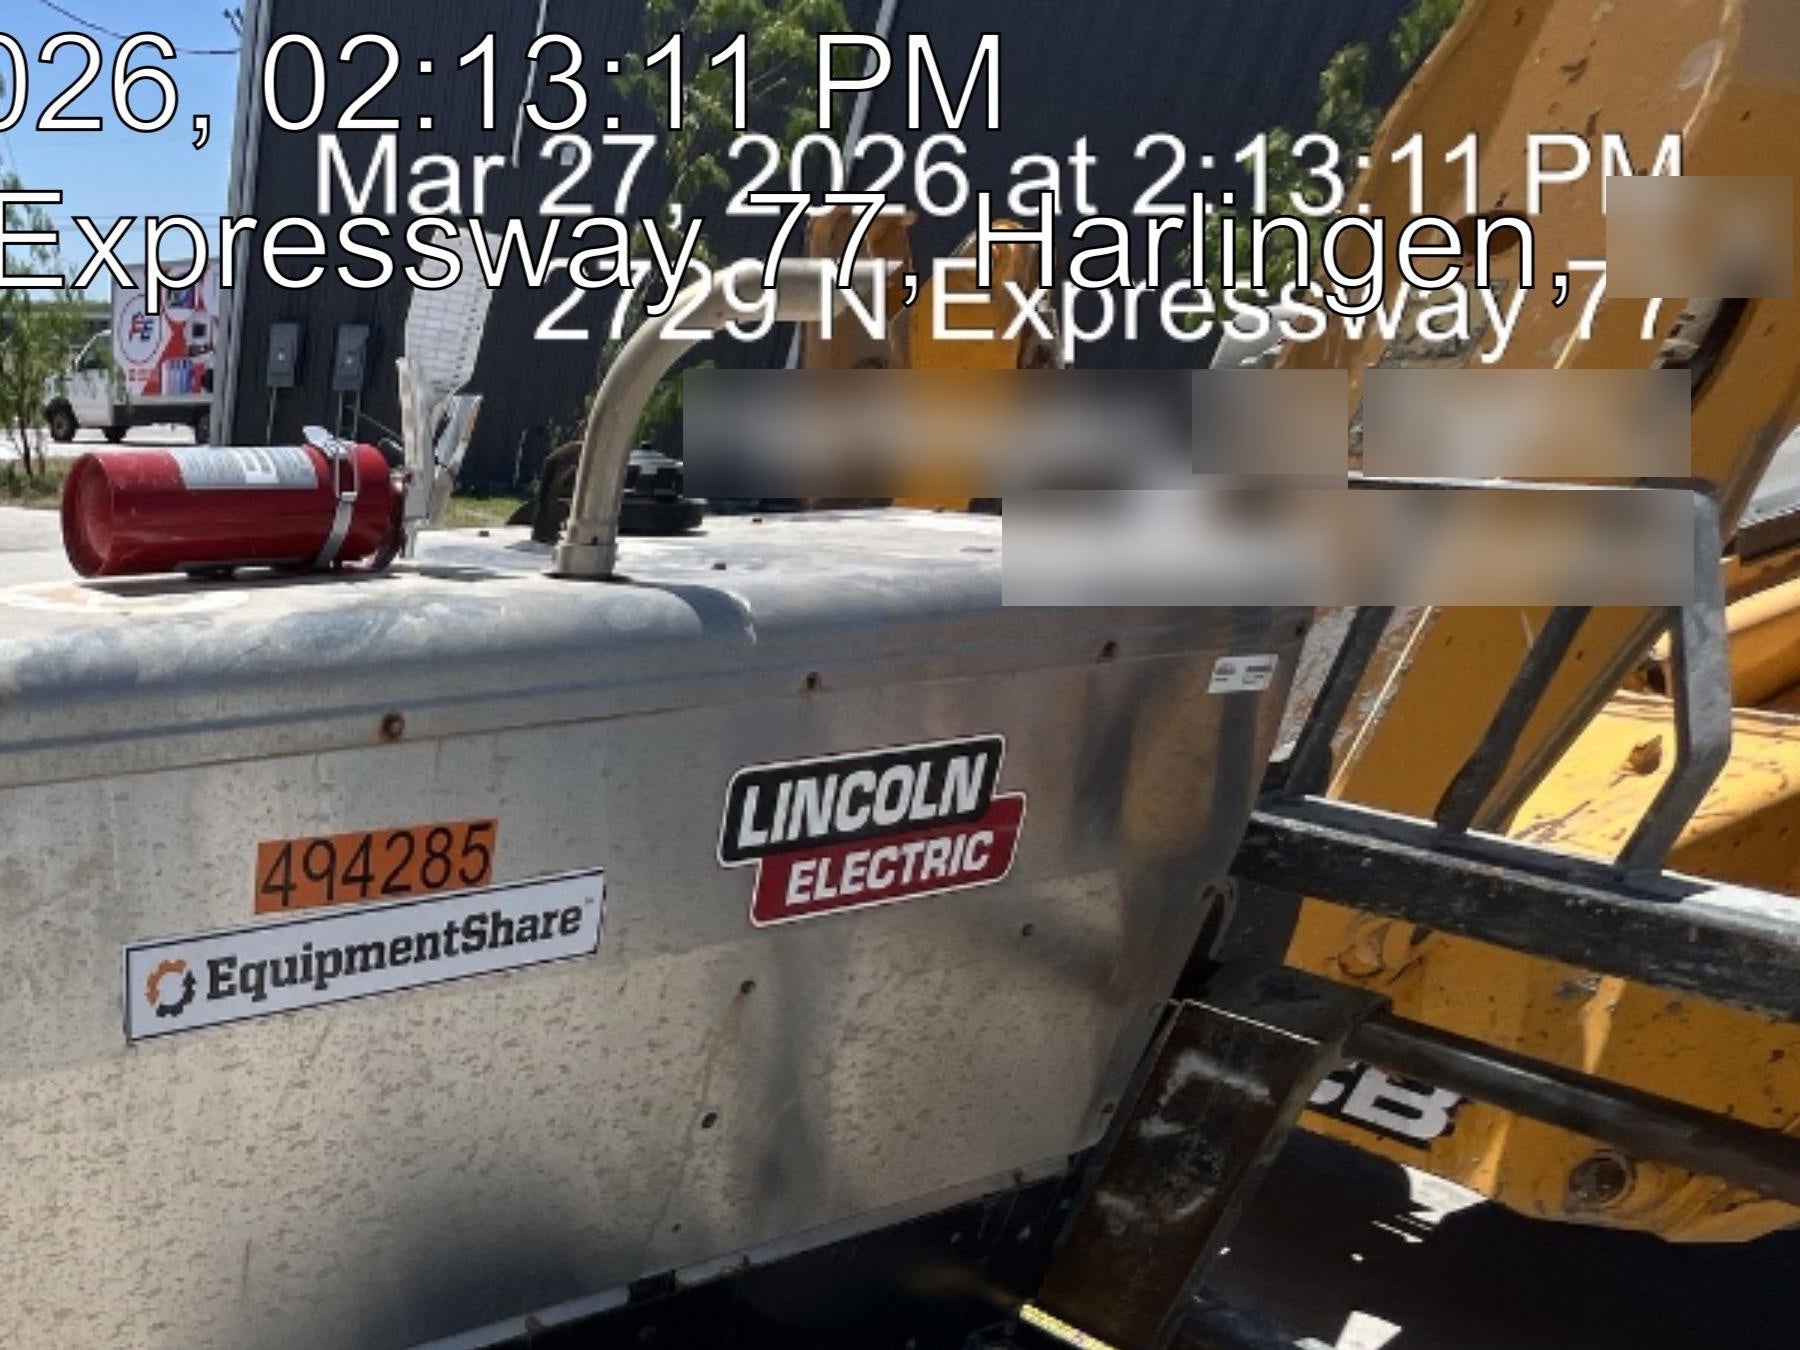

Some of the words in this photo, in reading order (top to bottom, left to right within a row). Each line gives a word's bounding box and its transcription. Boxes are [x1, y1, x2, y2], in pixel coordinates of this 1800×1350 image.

[737, 753, 988, 848] LINCOLN
[261, 823, 492, 906] 494285
[786, 831, 993, 905] ELECTRIC
[206, 905, 583, 1002] EquipmentShare
